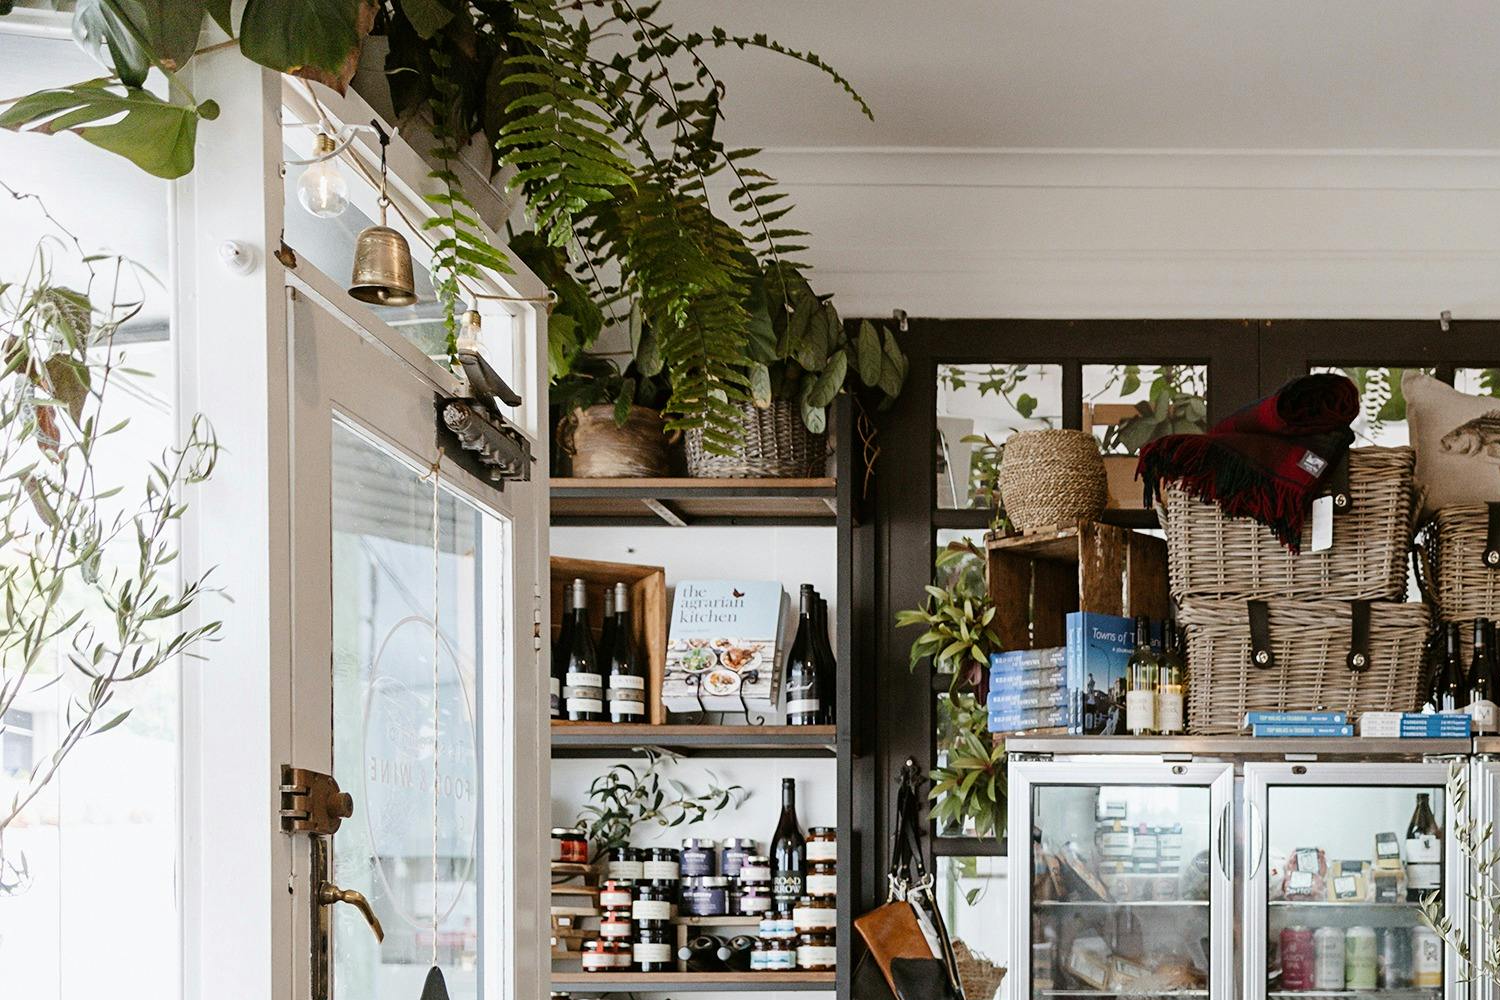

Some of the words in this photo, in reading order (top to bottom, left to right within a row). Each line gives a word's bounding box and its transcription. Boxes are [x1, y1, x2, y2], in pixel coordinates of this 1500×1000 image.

[683, 584, 707, 597] the
[681, 597, 744, 609] agrarian
[680, 609, 737, 623] kitchen
[1092, 627, 1117, 642] Towns
[1117, 631, 1127, 645] of
[773, 876, 801, 885] ROAD
[773, 884, 801, 894] RROW
